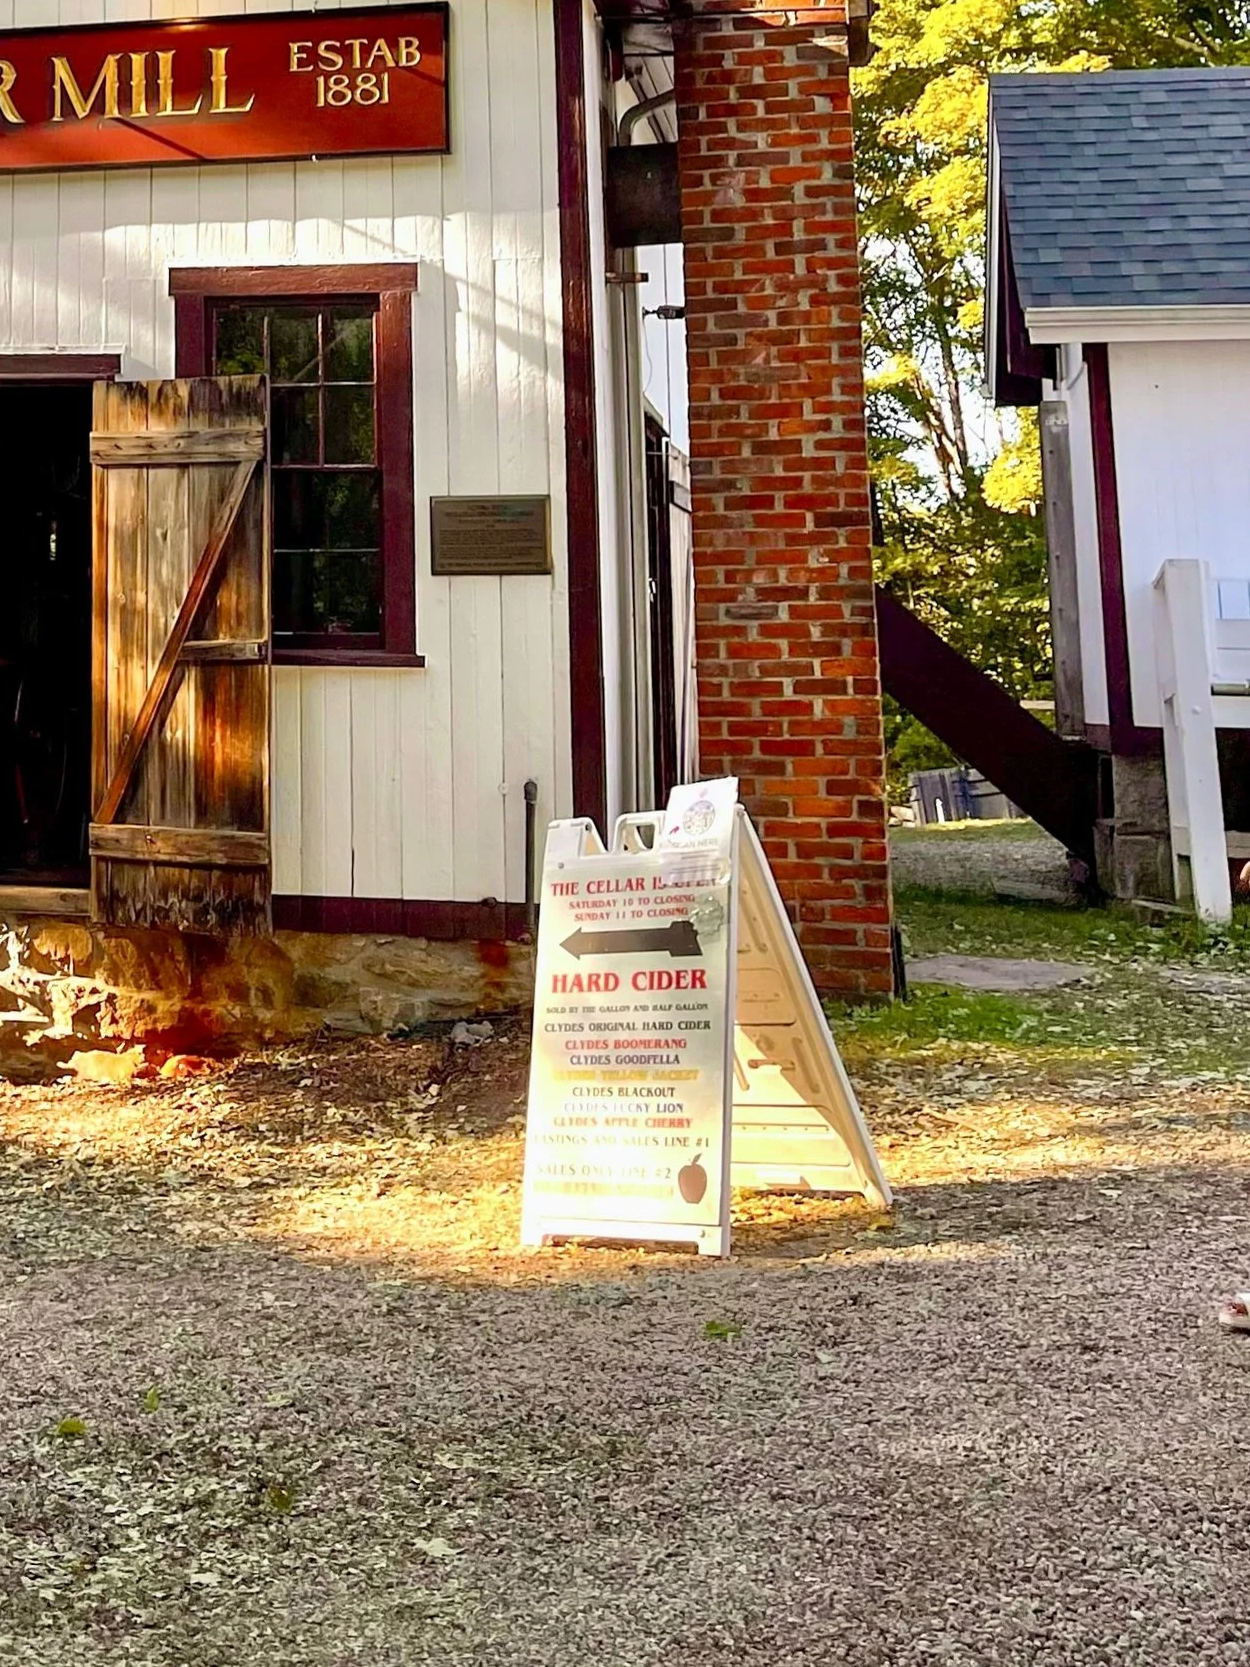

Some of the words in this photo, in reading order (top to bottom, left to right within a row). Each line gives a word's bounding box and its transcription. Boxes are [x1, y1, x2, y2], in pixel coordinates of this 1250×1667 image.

[288, 36, 422, 72] ESTAB
[51, 47, 256, 121] MILL
[315, 71, 390, 107] 1881
[550, 881, 579, 896] THE
[586, 877, 646, 894] CELLAR
[568, 898, 618, 910] SATURDAY
[622, 898, 634, 907] 10
[638, 897, 651, 906] TO
[653, 894, 695, 905] CLOSING
[574, 912, 610, 922] SUNDAY
[616, 910, 626, 919] 11
[631, 909, 644, 919] TO
[647, 906, 688, 917] CLOSING
[551, 971, 621, 994] HARD
[631, 968, 708, 991] CIDER
[546, 1006, 566, 1014] SOLD
[569, 1006, 579, 1014] BY
[582, 1005, 596, 1013] THE
[599, 1004, 631, 1013] GALLON
[633, 1004, 649, 1012] AND
[651, 1003, 672, 1012] HALF
[675, 1001, 708, 1011] GALLON
[544, 1022, 585, 1032] CLYDES
[588, 1021, 638, 1032] ORIGINAL
[642, 1021, 673, 1031] HARD
[677, 1020, 711, 1030] CIDER
[565, 1039, 609, 1050] CLYDES
[613, 1038, 687, 1049] BOOMERANG
[570, 1055, 611, 1065] CLYDES
[615, 1054, 680, 1065] GOODFELLA
[572, 1087, 613, 1097] CLYDES
[617, 1087, 676, 1097] BLACKOUT
[564, 1102, 608, 1112] CLYDES
[656, 1103, 683, 1113] LION
[553, 1117, 597, 1127] CLYDES
[604, 1118, 638, 1128] APPLE
[644, 1117, 693, 1128] CHERRY
[623, 1136, 659, 1147] SALES
[664, 1137, 690, 1147] LINE
[695, 1137, 709, 1148] #1
[537, 1164, 576, 1175] SALES
[655, 1168, 671, 1179] #2
